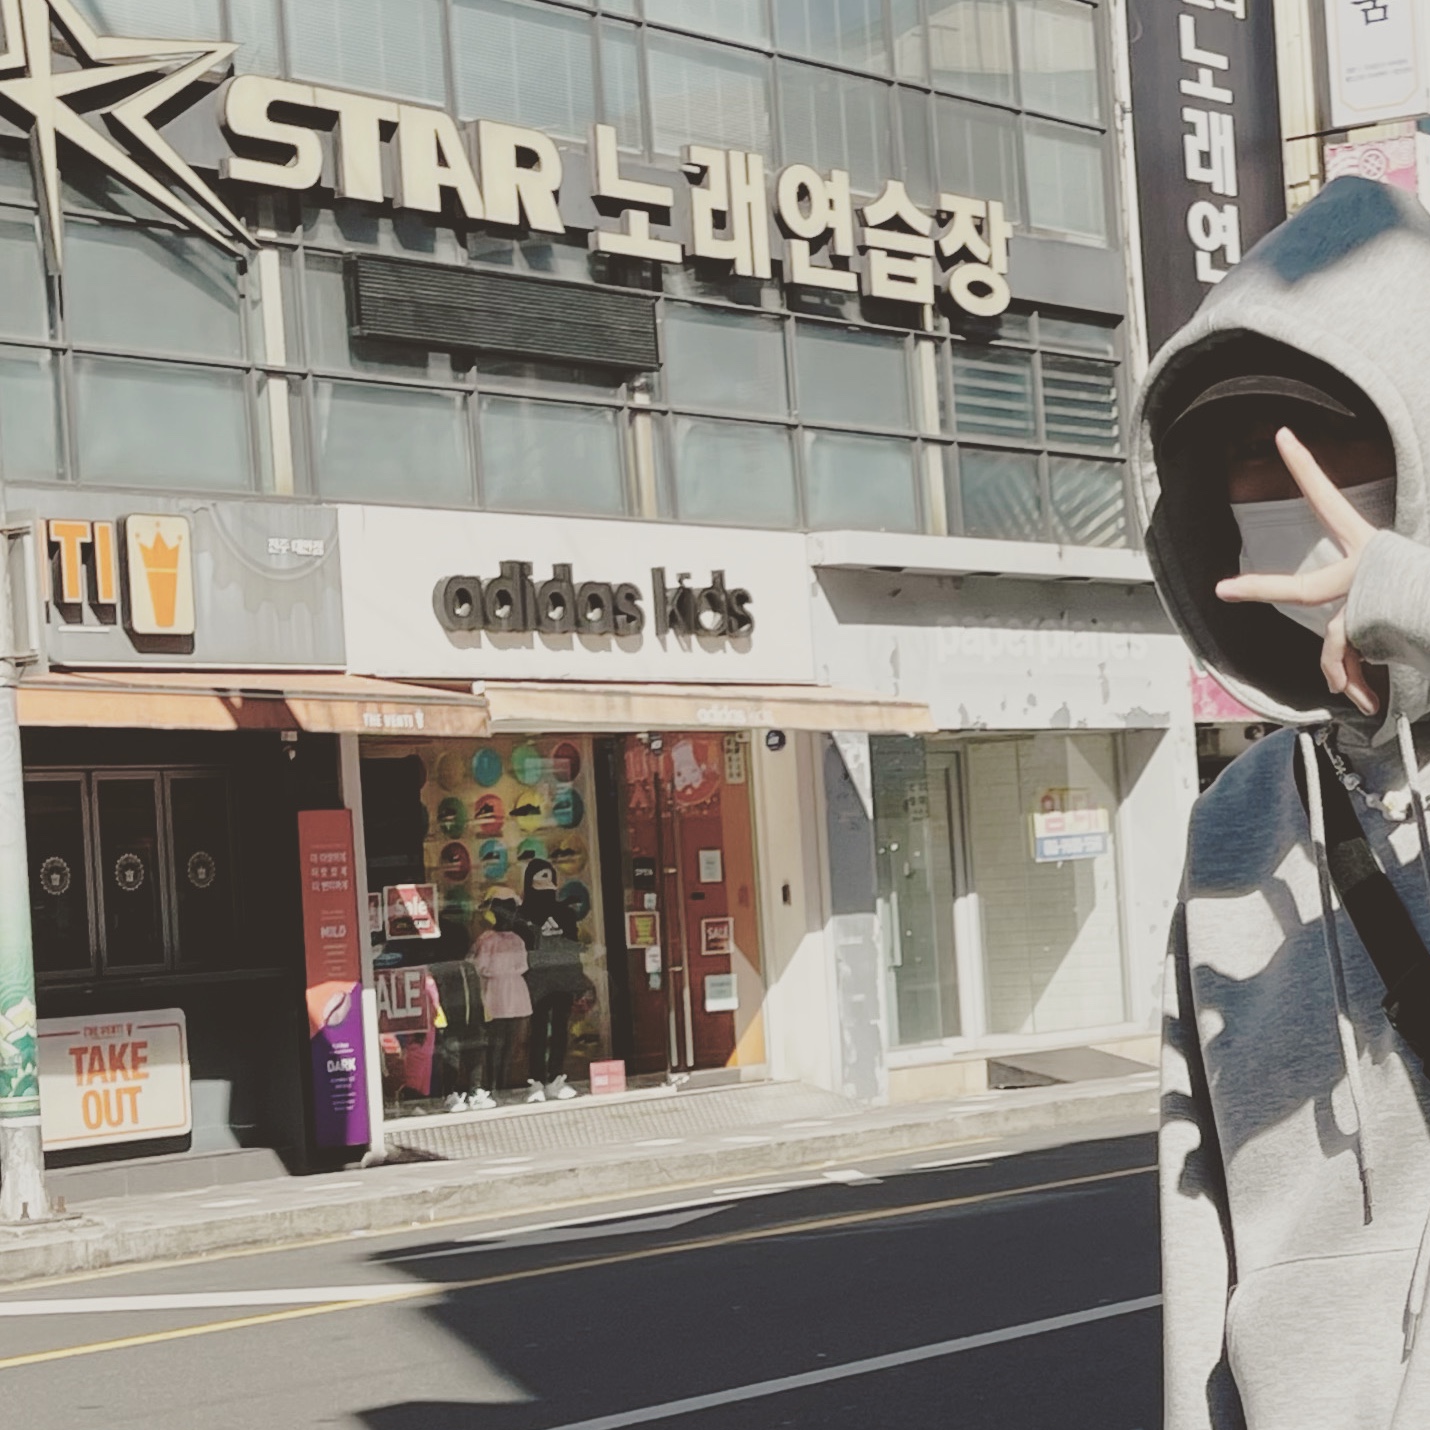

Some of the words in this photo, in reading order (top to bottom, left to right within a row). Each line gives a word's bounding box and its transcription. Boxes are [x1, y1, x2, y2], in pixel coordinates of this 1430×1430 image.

[222, 75, 565, 234] STAR
[593, 123, 1014, 317] 노래연습장
[433, 560, 645, 637] adidas
[650, 566, 755, 637] kids
[69, 1041, 149, 1086] TAKE
[327, 1057, 357, 1073] DARK
[82, 1086, 142, 1130] OUT
